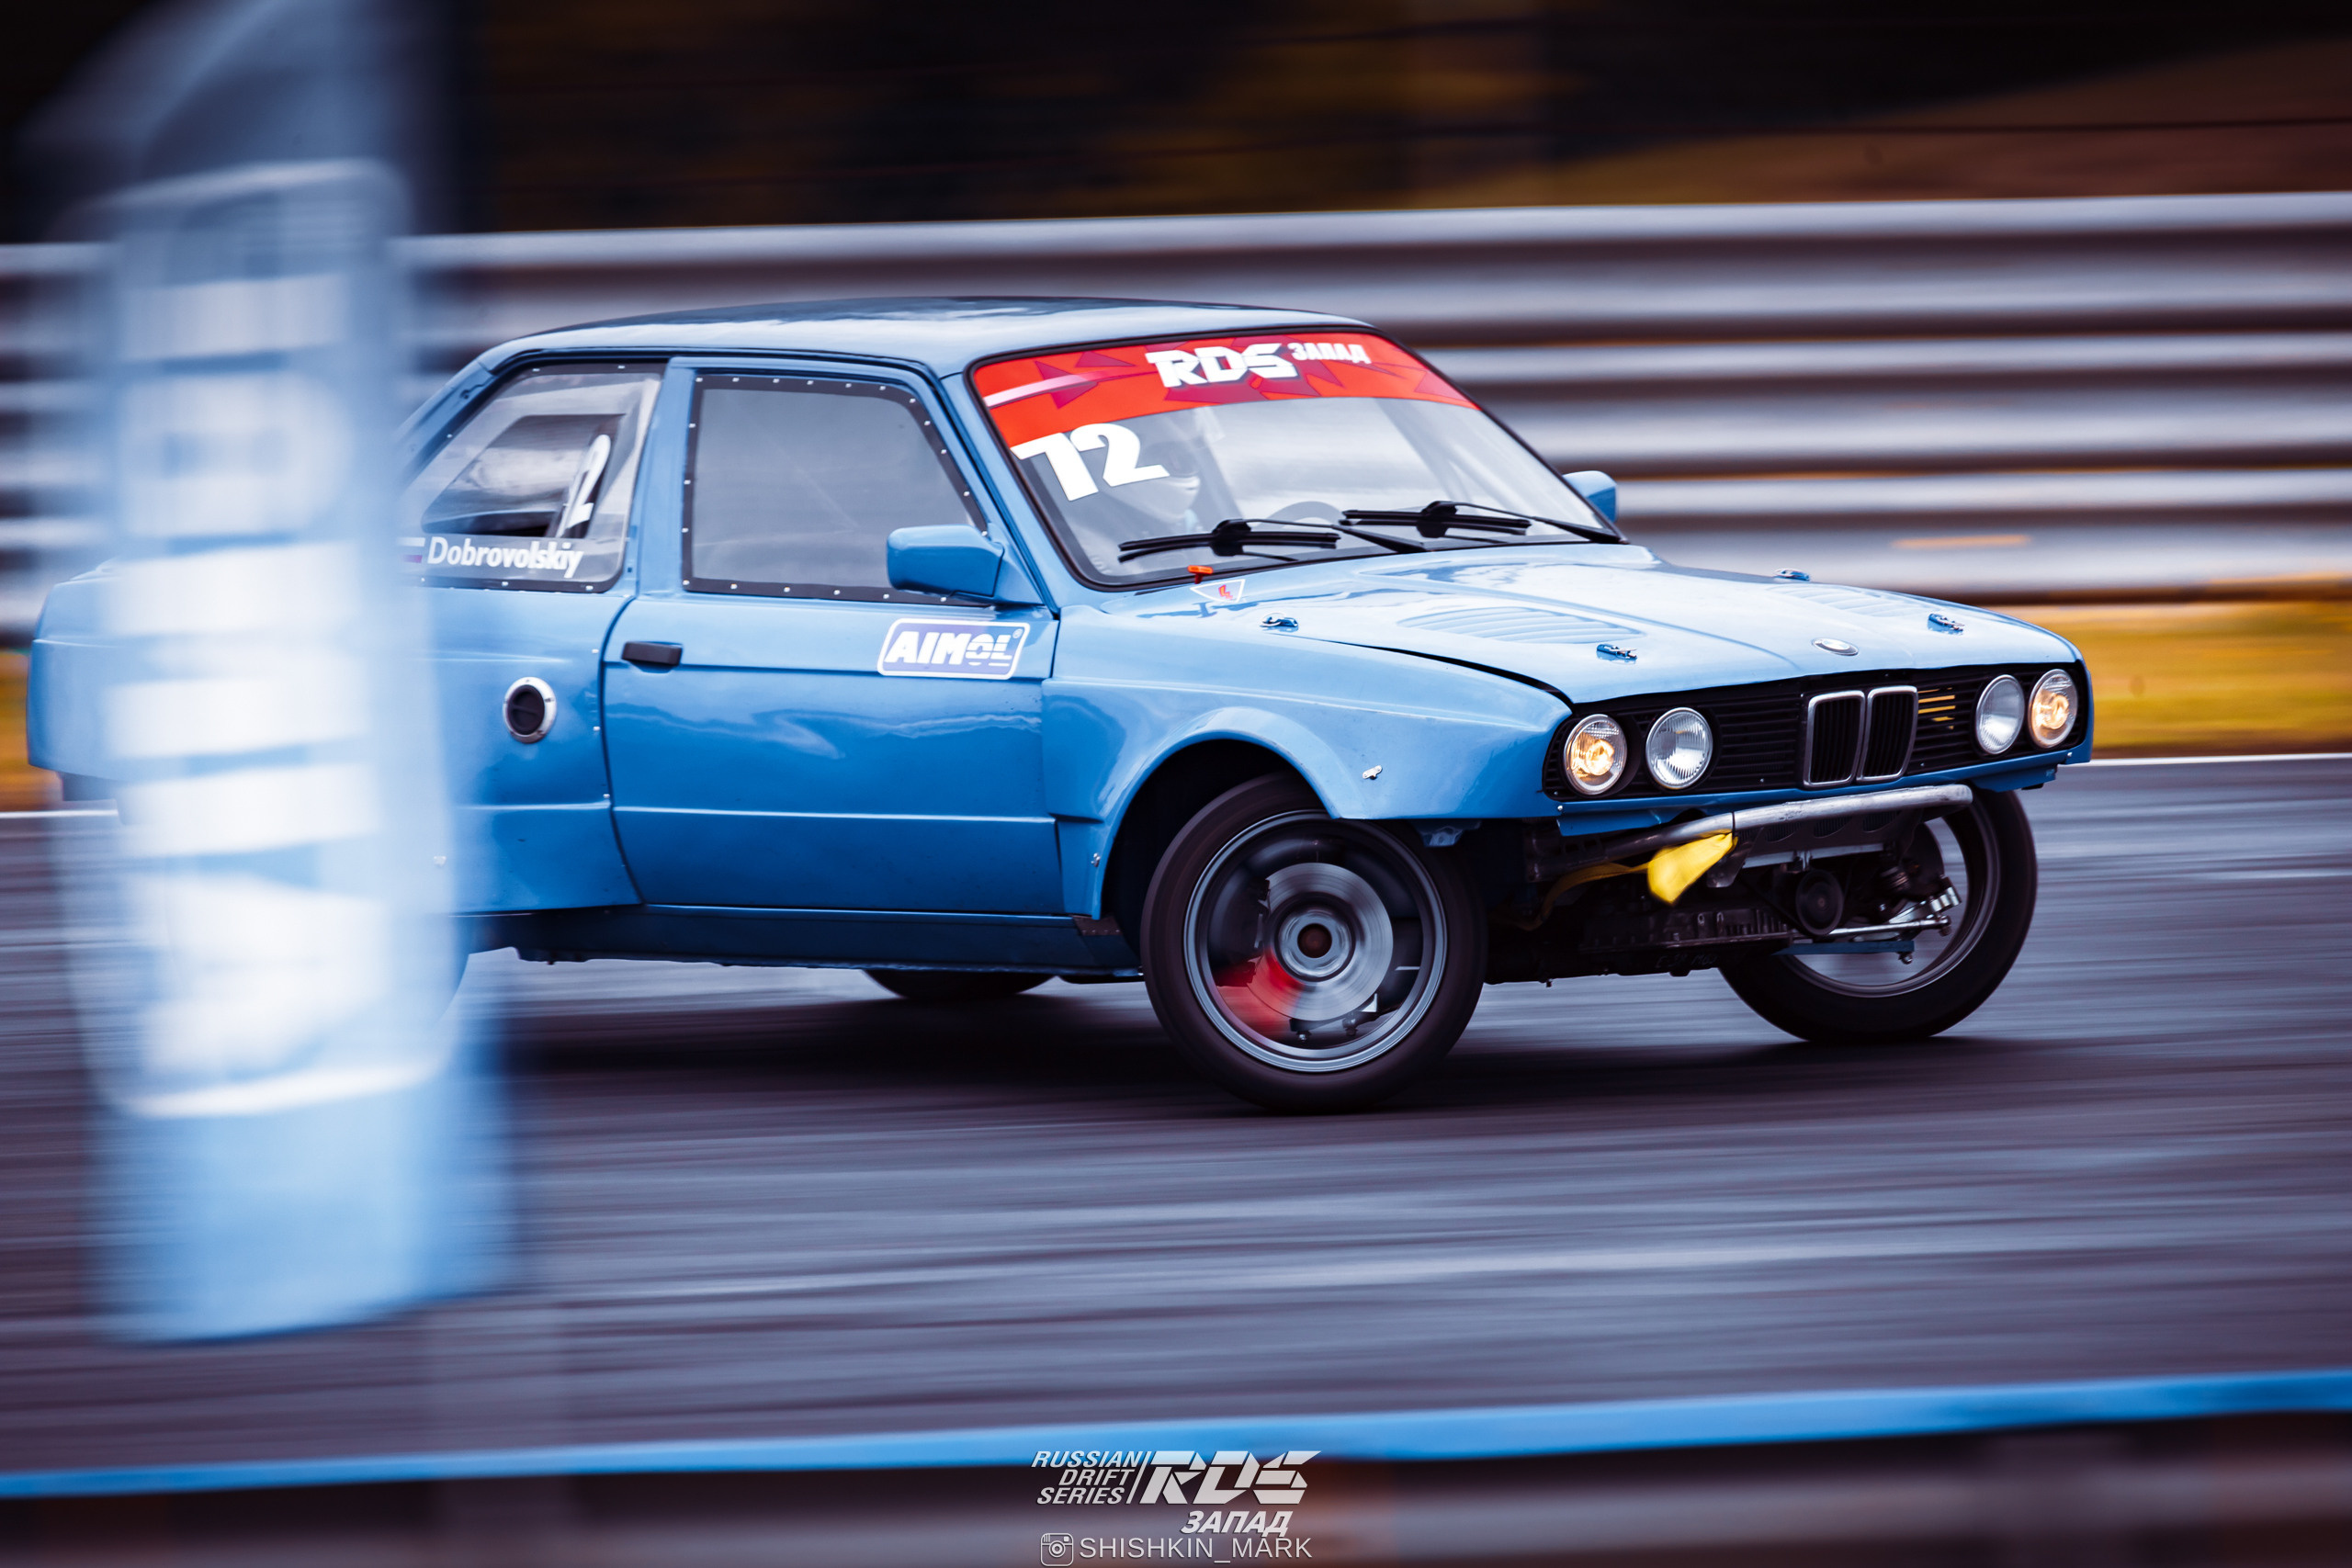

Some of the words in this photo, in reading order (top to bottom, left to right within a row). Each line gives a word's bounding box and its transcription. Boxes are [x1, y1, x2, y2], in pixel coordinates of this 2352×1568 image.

[1145, 343, 1297, 388] RDS
[1287, 343, 1372, 365] ЗАПАД
[1010, 423, 1170, 502] 72
[427, 536, 583, 579] Dobrovolskiy
[883, 630, 1013, 667] AIMOL
